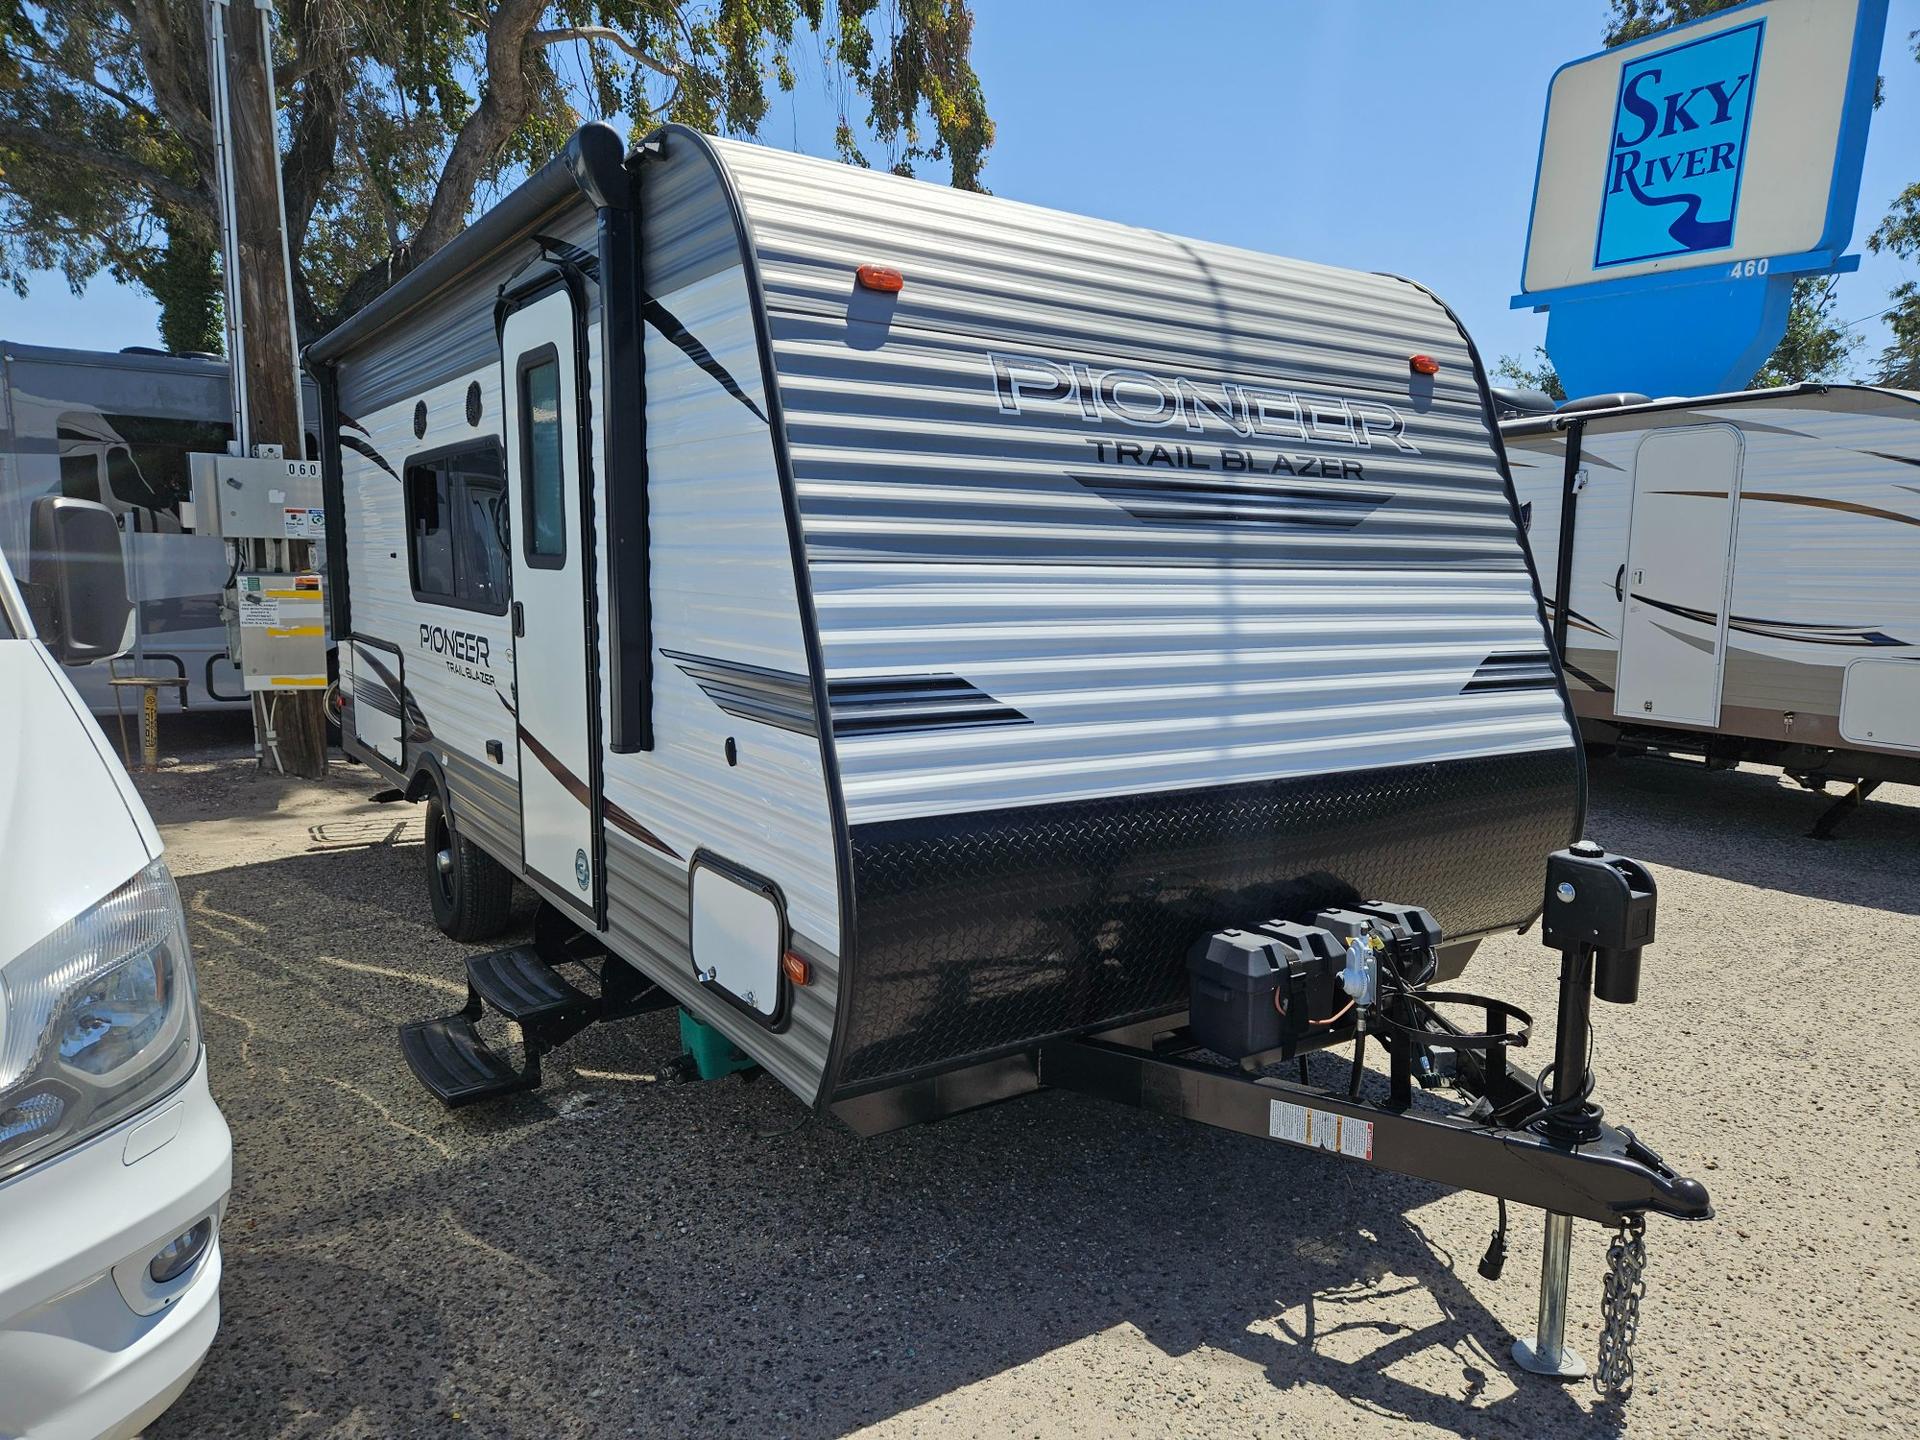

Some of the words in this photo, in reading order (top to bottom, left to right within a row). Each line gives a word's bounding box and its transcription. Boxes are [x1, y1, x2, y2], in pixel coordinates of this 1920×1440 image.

[1730, 258, 1769, 279] 460
[986, 350, 1422, 455] PIONEER
[288, 463, 317, 476] 060
[1085, 438, 1210, 471] TRAIL
[1219, 449, 1365, 481] BLAZER
[420, 623, 490, 668] PIONEER
[446, 660, 466, 678] TRAIL
[465, 667, 496, 687] BLAZER
